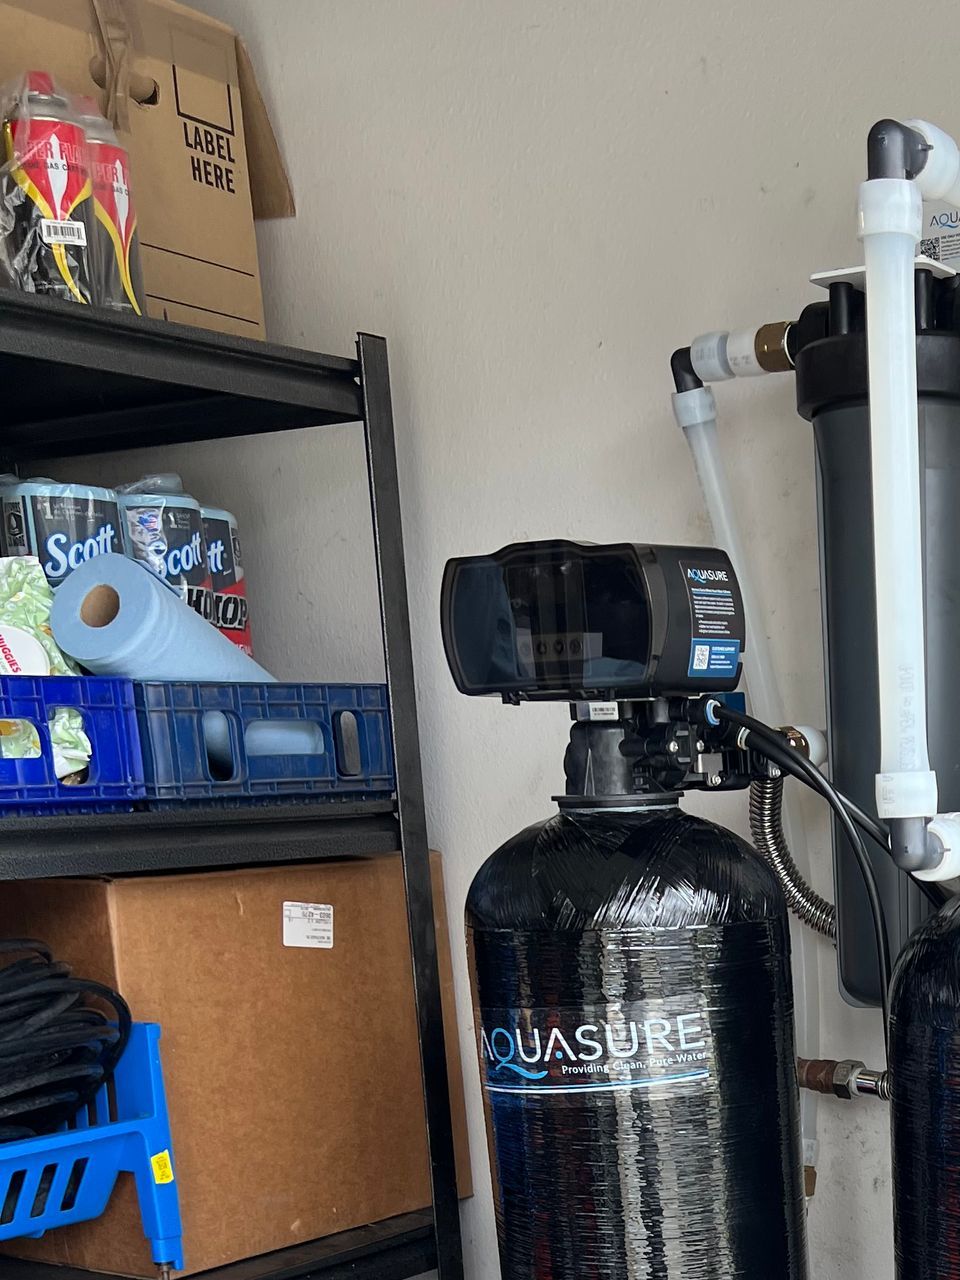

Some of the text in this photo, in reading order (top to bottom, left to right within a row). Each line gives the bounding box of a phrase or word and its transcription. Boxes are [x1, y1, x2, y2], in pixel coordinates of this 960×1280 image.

[184, 122, 236, 164] LABEL
[191, 156, 236, 194] HERE
[45, 524, 115, 578] Scott
[157, 531, 203, 579] cott
[687, 568, 729, 584] AQUASURE
[0, 633, 22, 674] UGGIES
[480, 1012, 706, 1080] AQUASURE
[561, 1062, 609, 1075] Providing
[648, 1056, 676, 1068] Pure
[676, 1051, 708, 1064] Water
